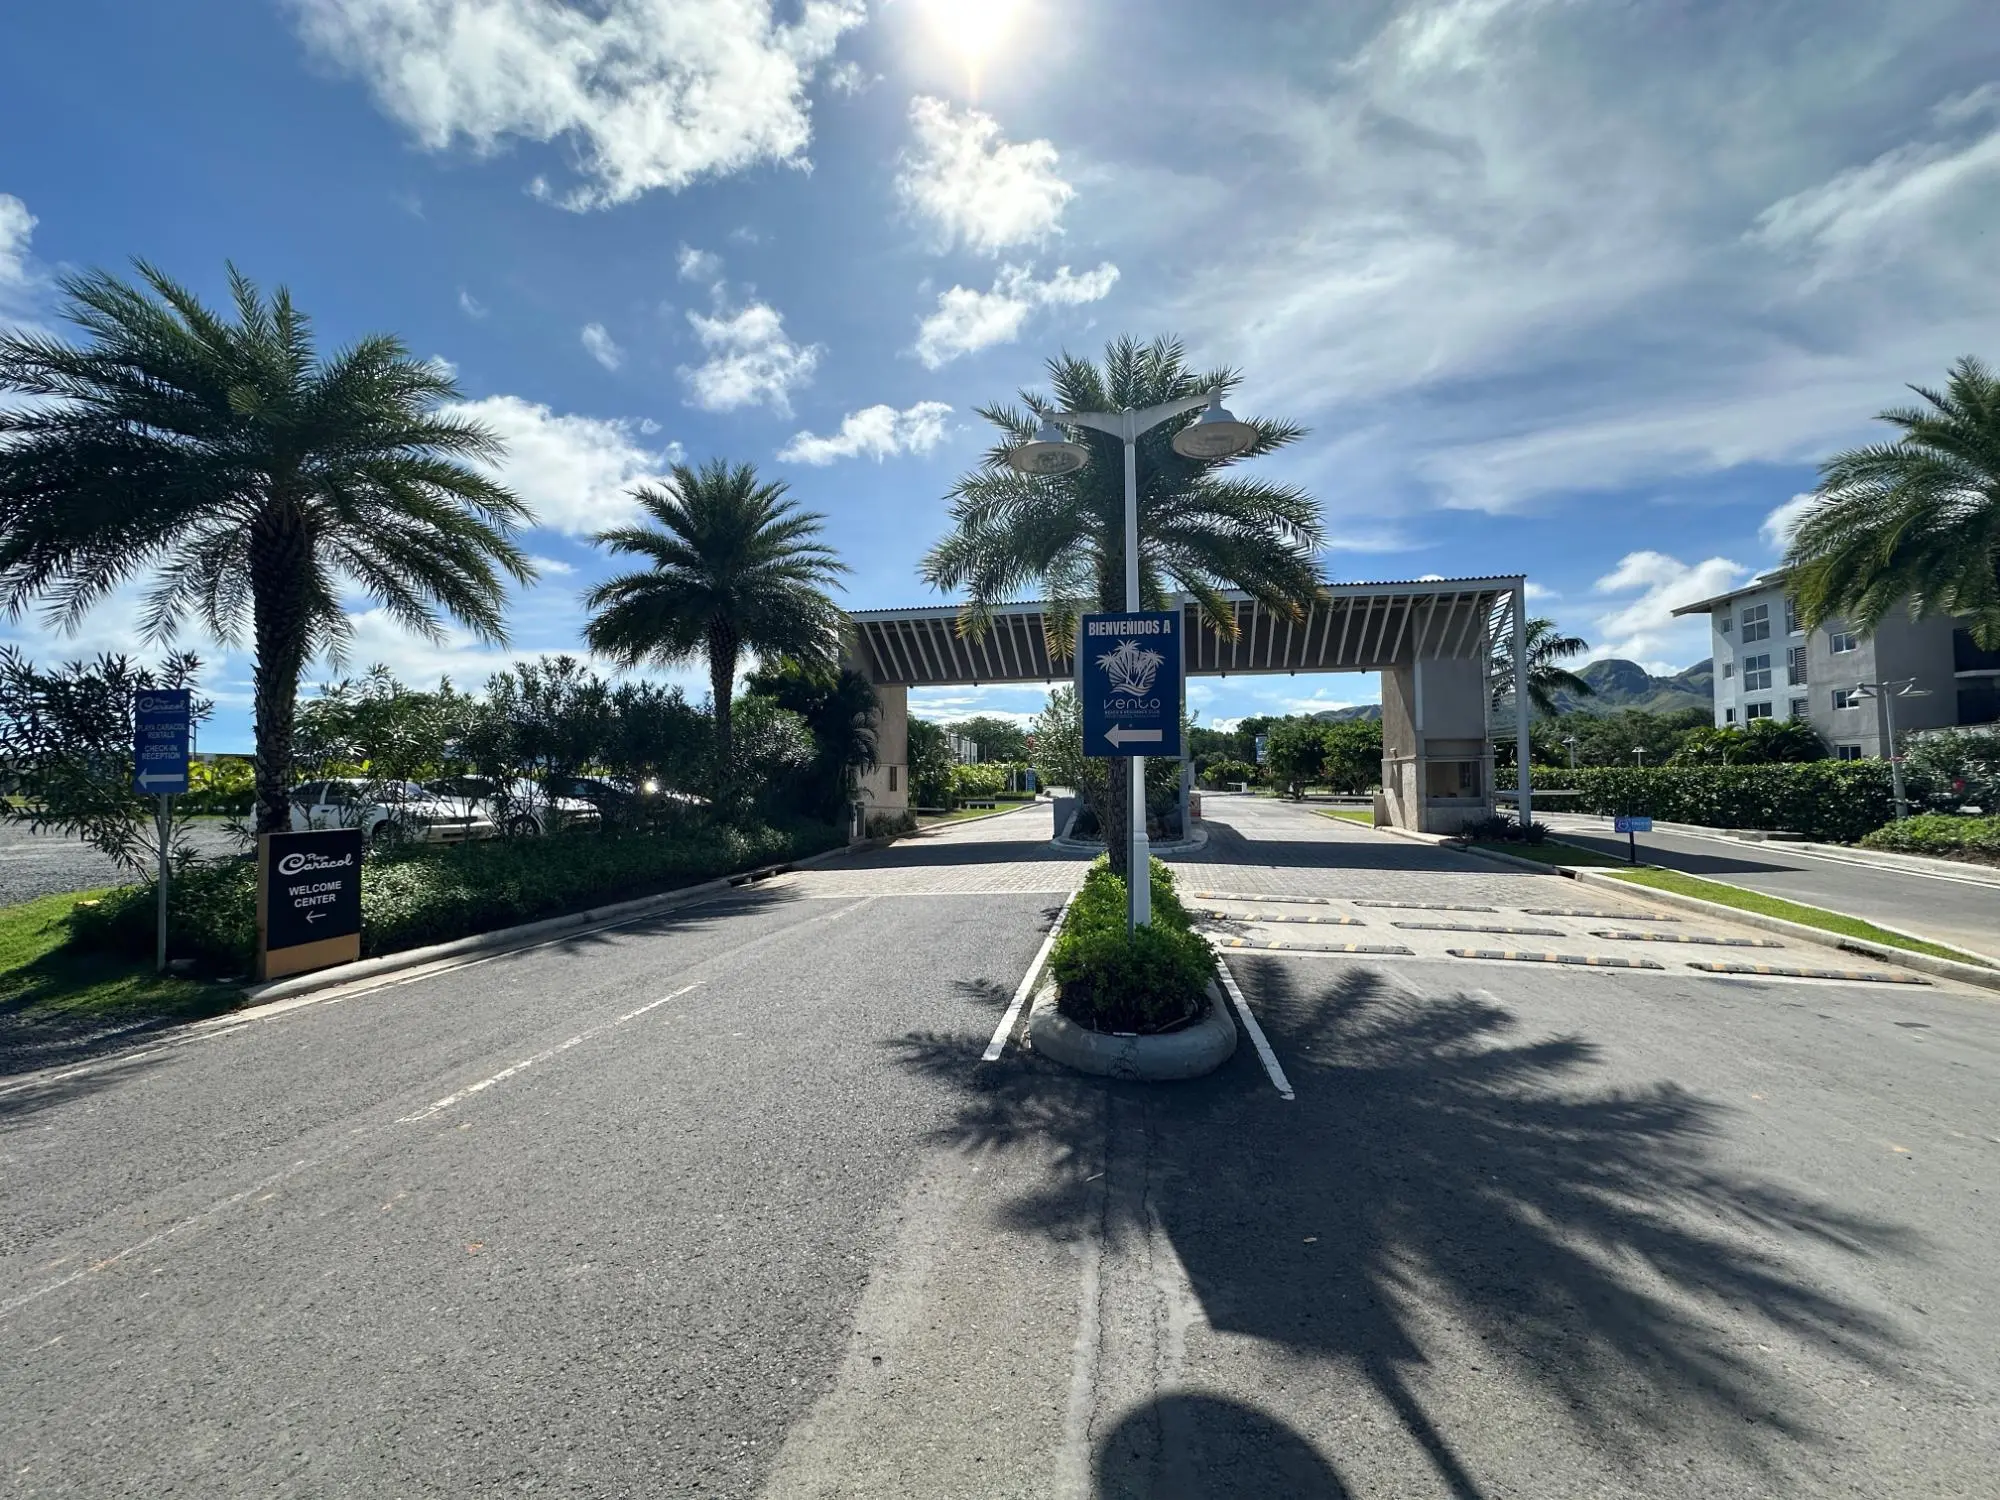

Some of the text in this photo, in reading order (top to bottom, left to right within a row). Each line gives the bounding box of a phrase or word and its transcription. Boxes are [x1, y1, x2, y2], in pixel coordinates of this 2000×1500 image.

[1088, 620, 1171, 636] BIENVENIDOS A
[138, 697, 186, 713] Caracol
[1103, 698, 1161, 709] vento
[147, 731, 176, 739] RENTALS
[144, 744, 178, 752] CHECK-IN
[141, 752, 180, 760] RECEPTION
[278, 853, 353, 875] Caracol
[288, 880, 342, 896] WELCOME
[294, 894, 336, 908] CENTER
